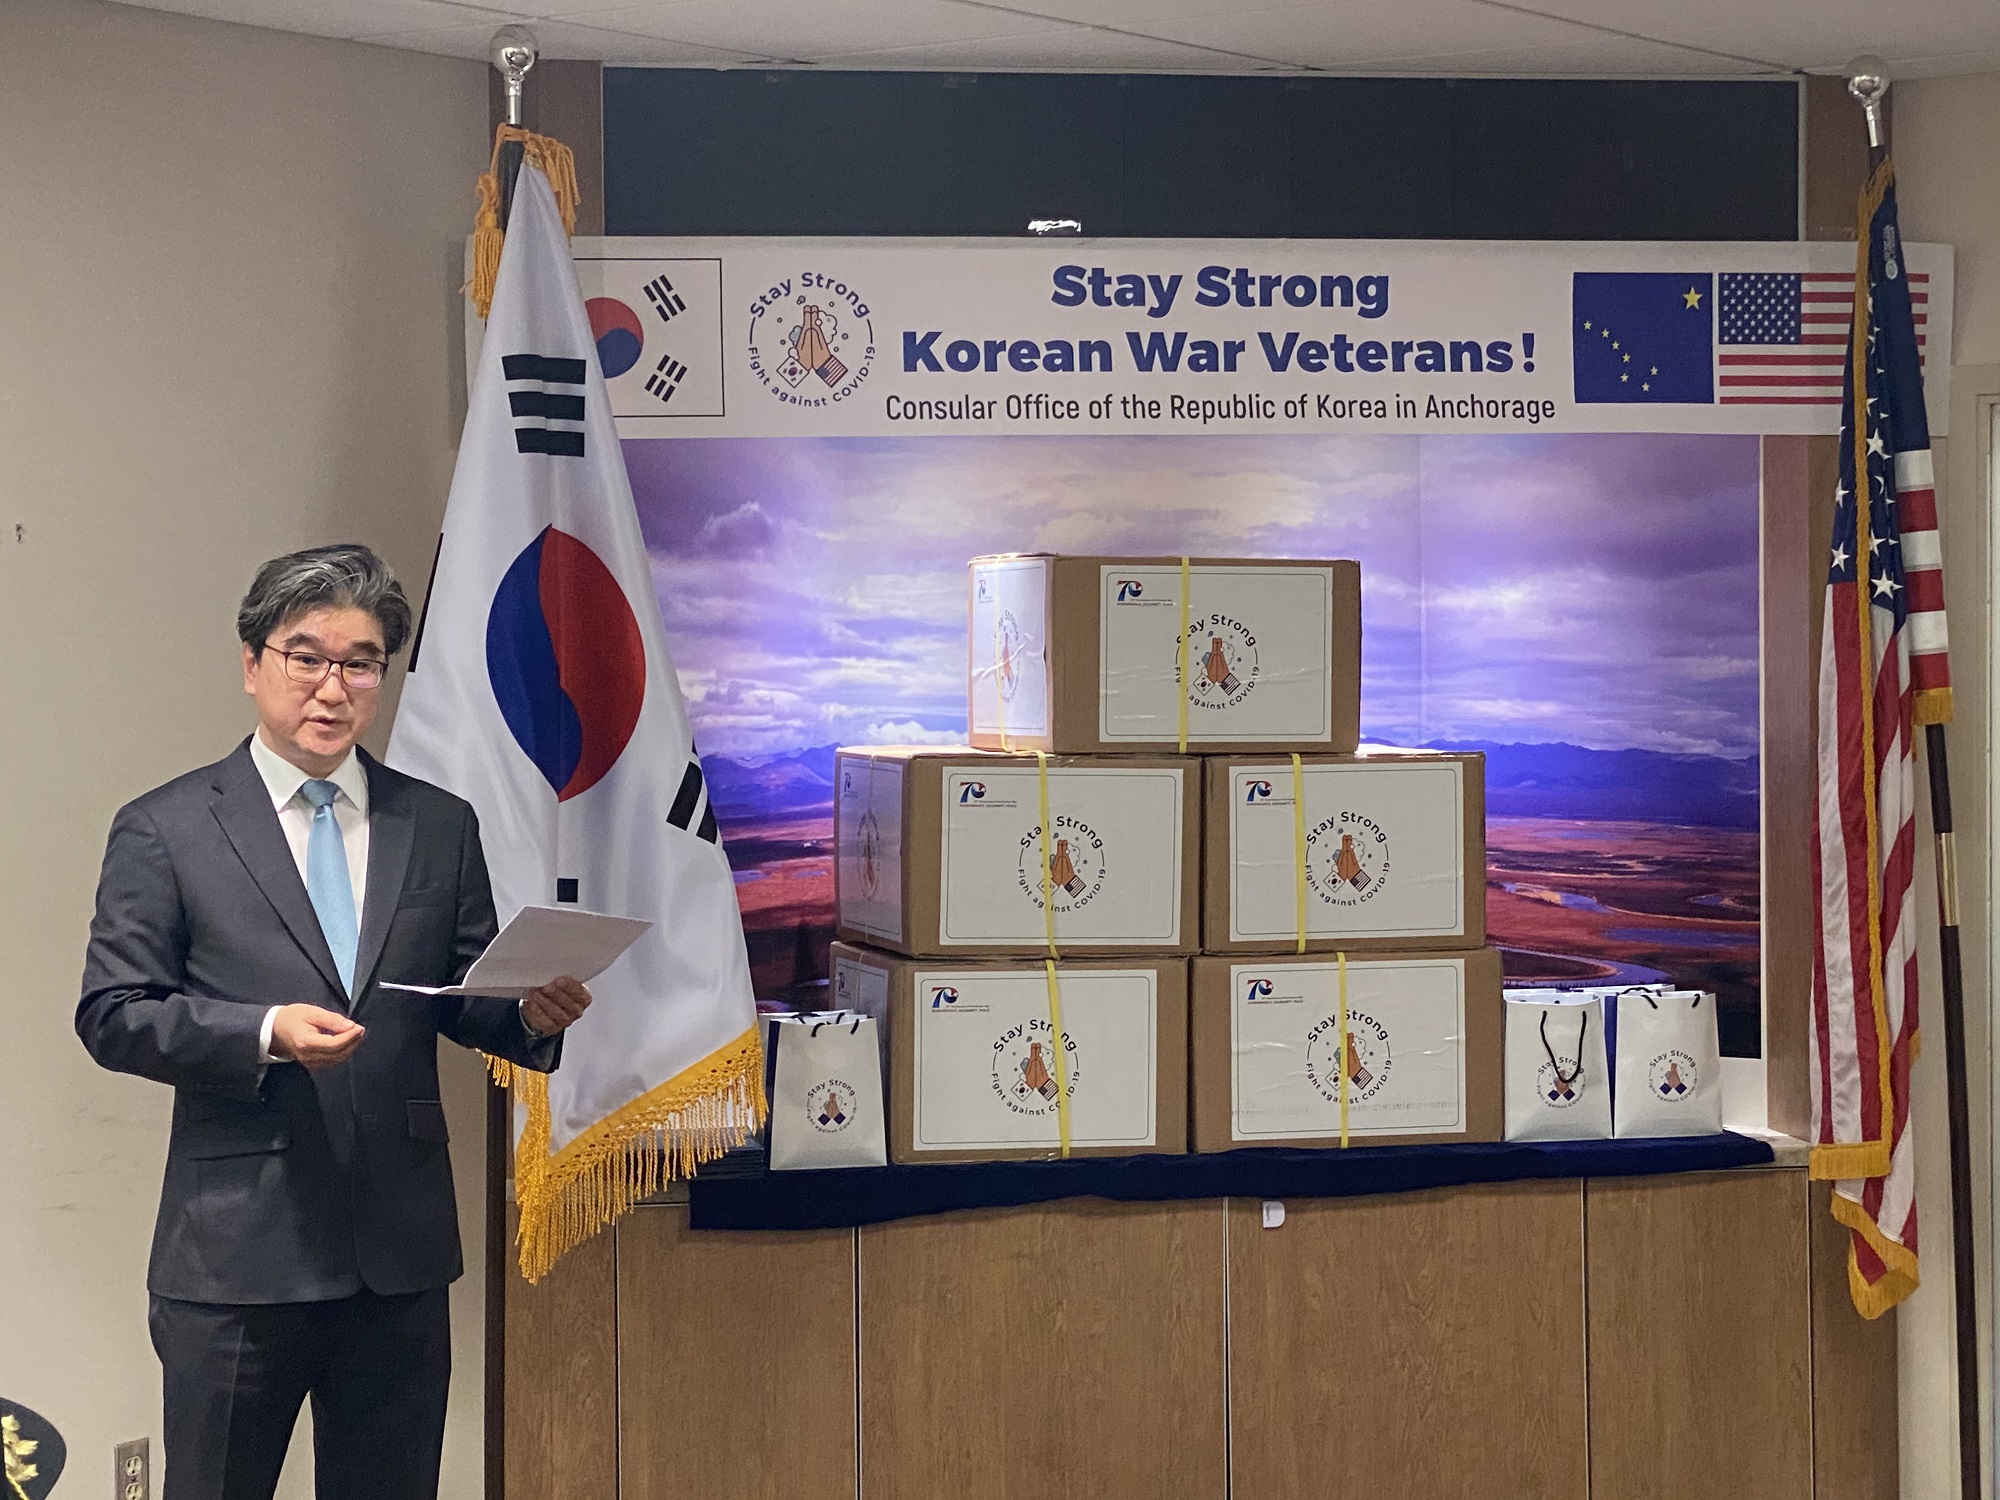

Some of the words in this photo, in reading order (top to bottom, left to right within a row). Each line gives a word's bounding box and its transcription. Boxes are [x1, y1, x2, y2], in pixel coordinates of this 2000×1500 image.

[750, 279, 791, 318] Stay
[801, 272, 870, 318] Strong
[1051, 265, 1183, 318] Stay
[1195, 265, 1390, 318] Strong
[903, 331, 1112, 372] Korean
[1126, 332, 1245, 372] War
[1258, 332, 1535, 372] Veterans!
[748, 347, 770, 386] Fight
[771, 386, 828, 407] against
[833, 346, 875, 402] COVID-19
[886, 394, 997, 420] Consular
[1006, 394, 1080, 420] Office
[1088, 394, 1113, 419] of
[1120, 394, 1161, 419] the
[1170, 394, 1276, 425] Republic
[1284, 394, 1308, 419] of
[1316, 394, 1387, 419] Korea
[1395, 394, 1417, 419] in
[1425, 393, 1556, 424] Anchorage
[1211, 614, 1256, 647] Strong
[1189, 694, 1226, 710] against
[1229, 666, 1260, 706] COVID-19
[1021, 820, 1049, 848] Sta
[1056, 816, 1103, 849] Strong
[1306, 816, 1334, 844] Stay
[1341, 811, 1386, 843] Strong
[1018, 869, 1032, 896] Fight
[1033, 897, 1071, 912] aginst
[1074, 869, 1106, 908] COVID-19
[1305, 865, 1319, 891] Fight
[1319, 892, 1357, 906] against
[1360, 862, 1390, 902] COVID-19
[993, 1024, 1023, 1052] Stay
[1030, 1019, 1077, 1052] Strng
[1308, 1014, 1336, 1043] Stay
[1559, 1056, 1585, 1074] Strog
[1650, 1052, 1667, 1068] Stay
[1670, 1050, 1696, 1068] Strong
[807, 1082, 826, 1098] Stay
[829, 1079, 855, 1097] Strong
[992, 1073, 1006, 1100] Fight
[1006, 1101, 1045, 1115] against
[1048, 1071, 1080, 1112] COID-19
[1306, 1063, 1321, 1089] Fight
[1362, 1060, 1392, 1100] COVID-19
